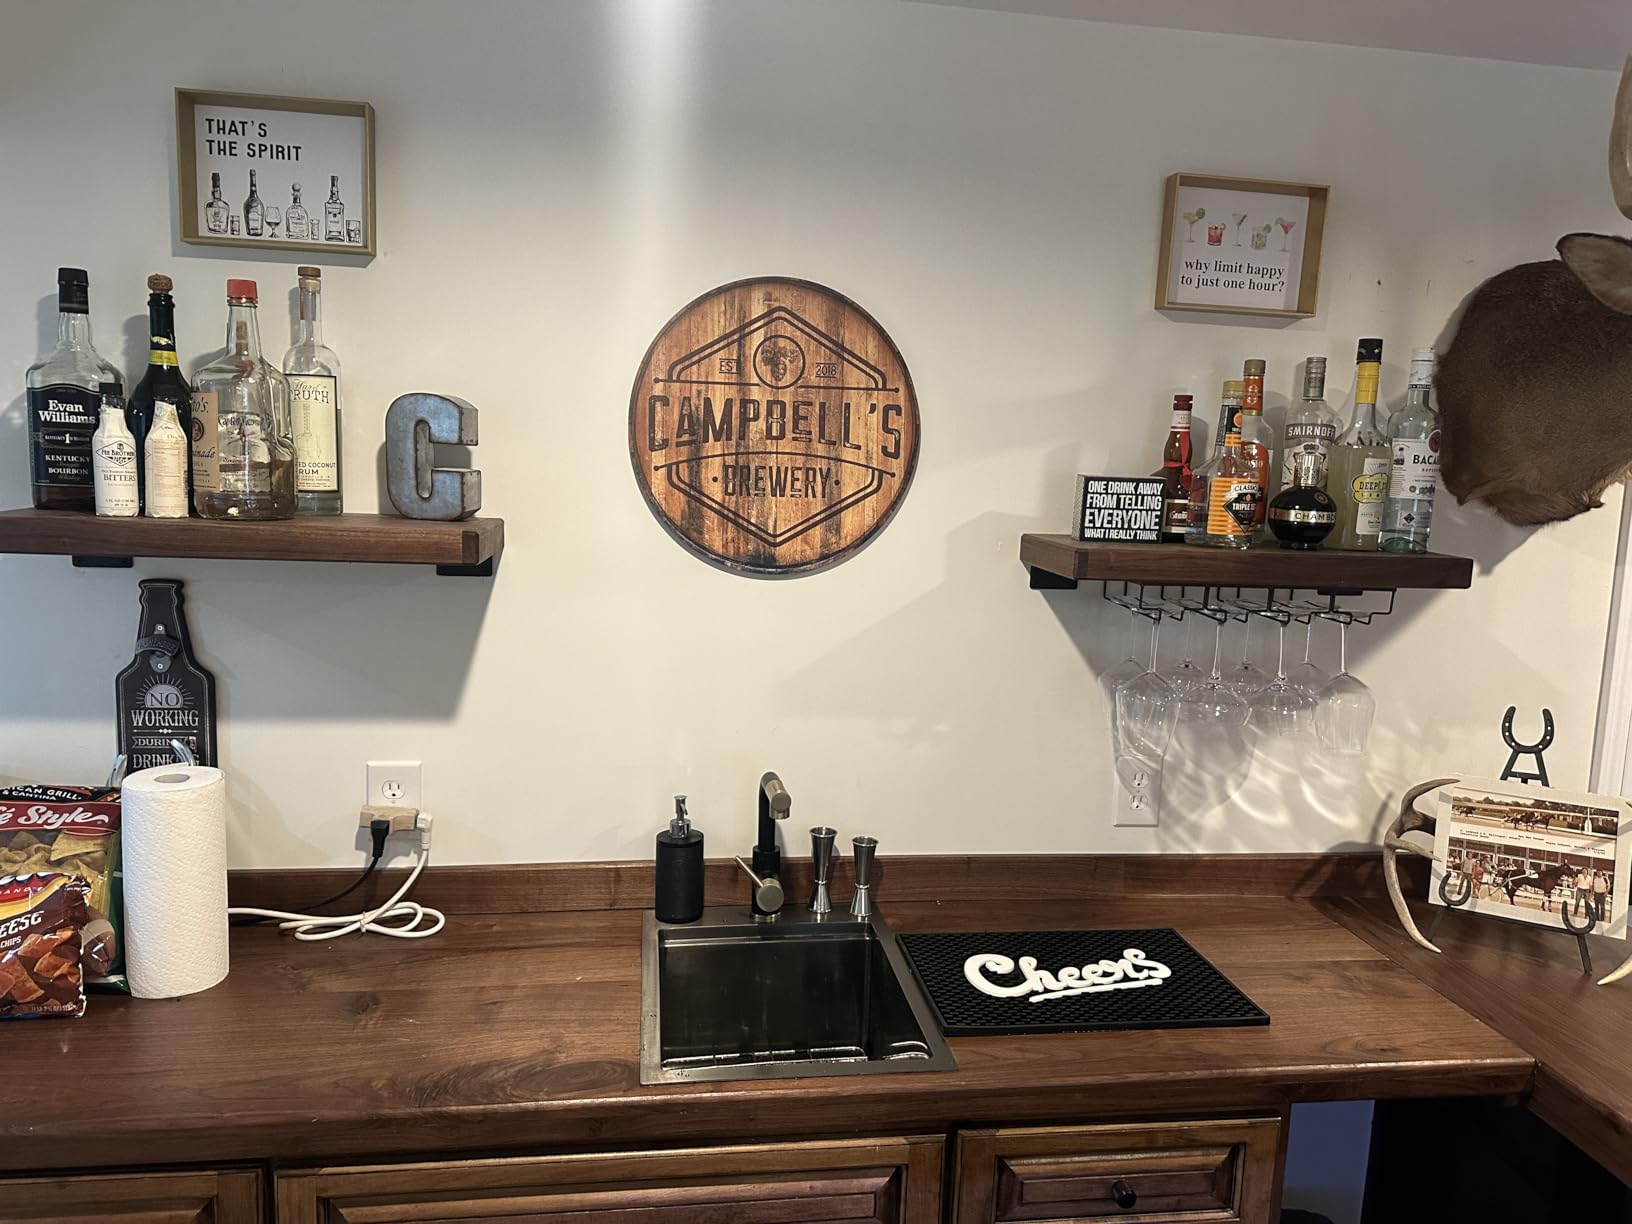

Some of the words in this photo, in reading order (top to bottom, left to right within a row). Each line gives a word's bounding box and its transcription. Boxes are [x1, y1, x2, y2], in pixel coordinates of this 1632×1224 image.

[205, 118, 268, 138] THAT'S
[206, 139, 238, 157] THE
[247, 142, 302, 161] SPIRIT
[1184, 259, 1211, 274] why
[1214, 260, 1243, 274] limit
[1246, 263, 1285, 280] happy
[1180, 274, 1193, 286] to
[1195, 275, 1220, 289] just
[1223, 280, 1245, 290] one
[1248, 279, 1285, 293] hour?
[815, 364, 837, 376] 2018
[48, 400, 85, 413] Evan
[38, 410, 97, 424] Williams
[648, 394, 903, 460] CAMPBELL'S
[1287, 425, 1335, 437] SMIRNOFF
[45, 454, 90, 463] KENTUCKY
[1413, 454, 1440, 465] BACA
[48, 467, 89, 475] BOURBON
[103, 474, 136, 482] BITTERS
[724, 465, 832, 498] BREWERY
[1088, 480, 1107, 494] ONE
[1107, 481, 1137, 495] DRINK
[1137, 482, 1163, 496] AWAY
[1086, 493, 1118, 508] FROM
[1119, 494, 1162, 510] TELLING
[1084, 508, 1161, 530] EVERYONE
[1295, 512, 1335, 522] CHAMBO
[1084, 528, 1105, 538] WHAT
[1109, 529, 1136, 540] REALLY
[1136, 530, 1157, 540] THINK
[149, 692, 180, 706] NO
[131, 710, 199, 727] WORKING
[138, 738, 182, 747] DURIN
[12, 791, 57, 800] CANTINA
[47, 789, 77, 800] GRILL
[17, 805, 109, 830] Style
[0, 911, 45, 938] EESE
[0, 936, 22, 949] CHIPS
[964, 949, 1172, 998] Cheers
